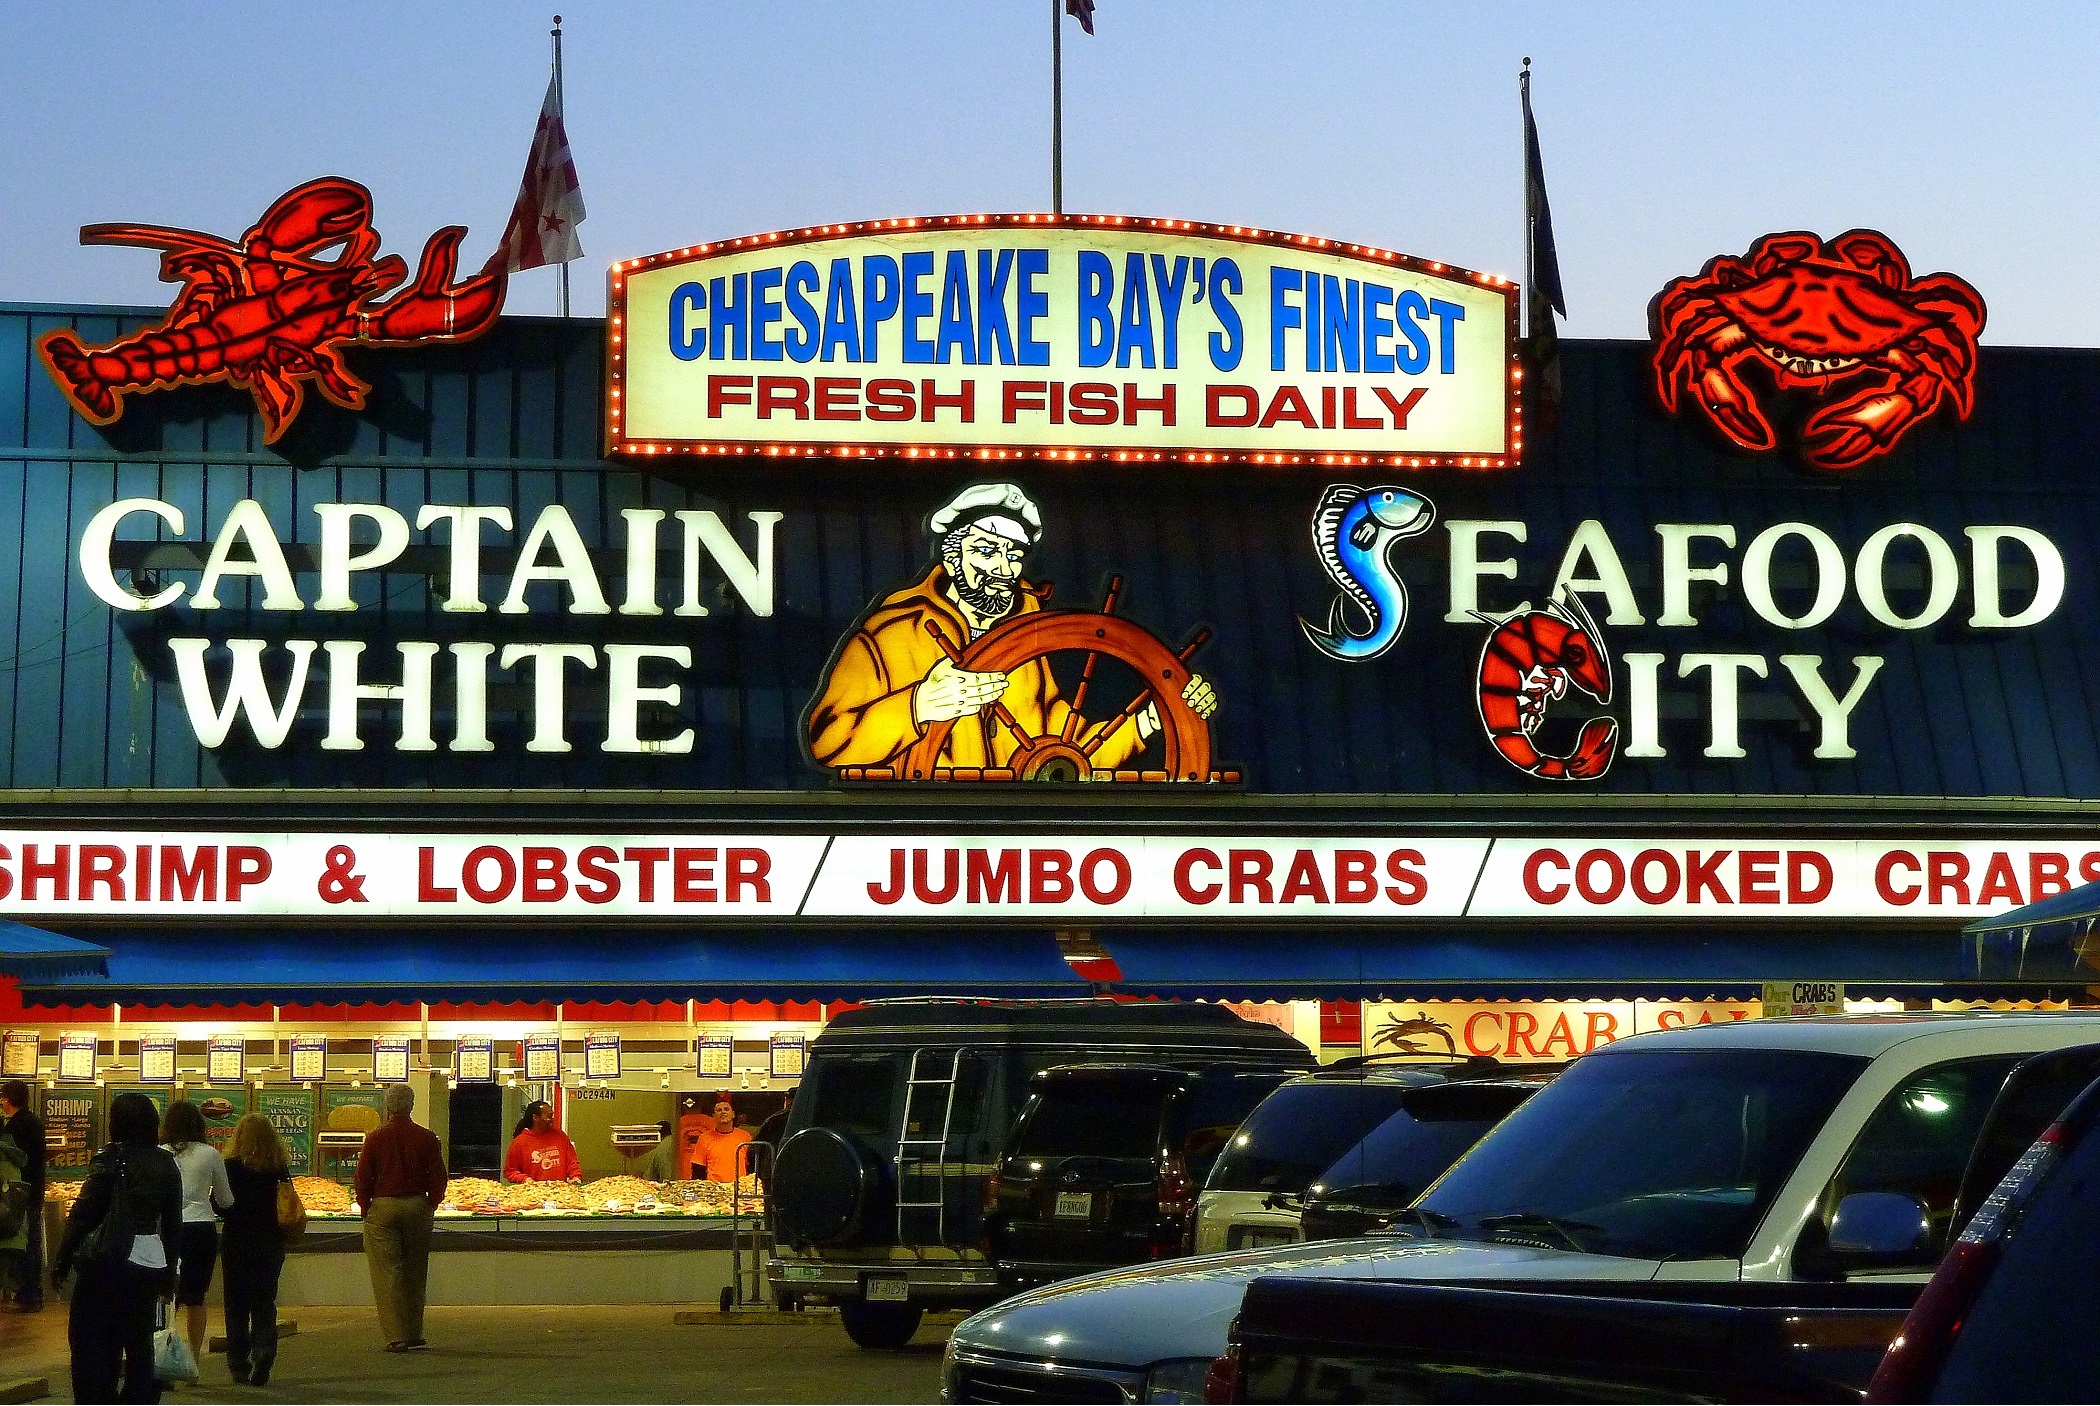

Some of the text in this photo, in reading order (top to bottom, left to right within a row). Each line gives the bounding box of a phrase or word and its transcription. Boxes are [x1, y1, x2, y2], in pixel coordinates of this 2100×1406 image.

[668, 249, 1466, 375] CHESAPEAKE BAY'S FINEST
[707, 375, 1429, 430] FRESH FISH DAILY
[79, 498, 785, 617] CAPTAIN
[167, 637, 696, 754] WHITE
[317, 844, 368, 904] &
[418, 845, 772, 904] LOBSTER
[867, 848, 1133, 906] JUMBO
[1173, 848, 1428, 906] CRABS
[1523, 848, 1834, 906] COOKED
[1792, 982, 1836, 1003] CRABS
[1463, 1010, 1618, 1058] CRAB
[46, 1099, 93, 1116] SHRIMP
[577, 1090, 616, 1100] DC2944N
